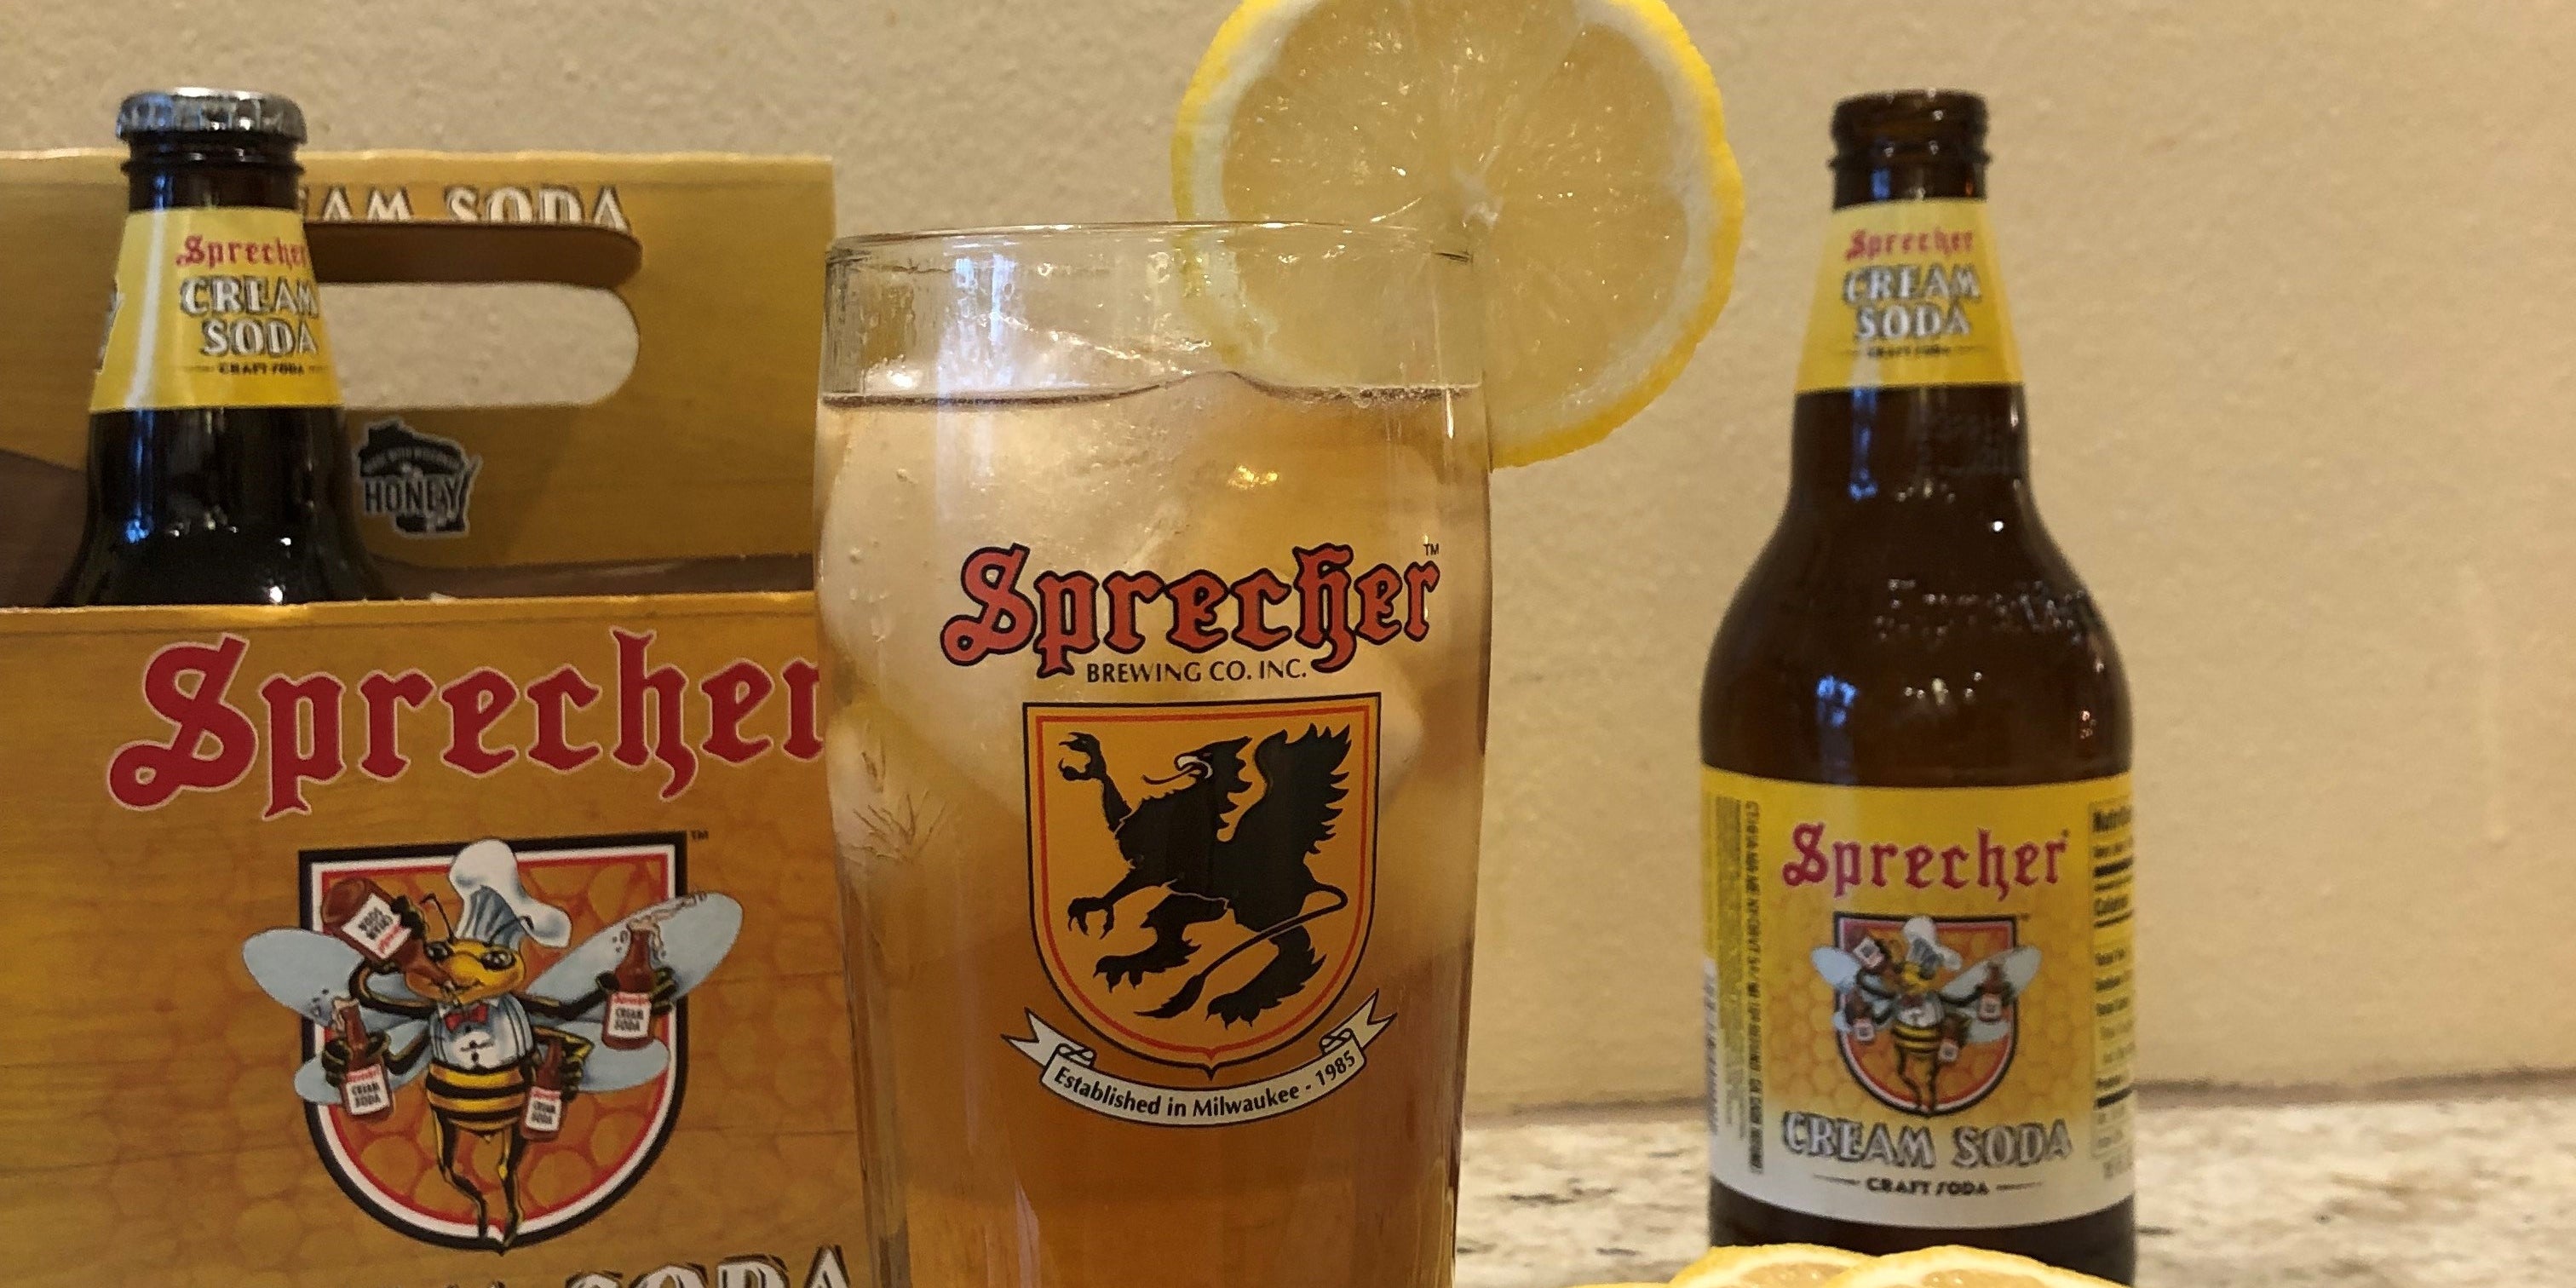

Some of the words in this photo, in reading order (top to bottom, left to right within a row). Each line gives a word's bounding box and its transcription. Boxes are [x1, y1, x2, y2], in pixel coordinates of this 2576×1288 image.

[180, 273, 319, 319] CREAM
[1842, 262, 1982, 308] CREAM
[199, 316, 319, 358] SODA
[1854, 299, 1972, 342] SODA
[365, 476, 465, 513] HONEY
[940, 543, 1440, 678] Sprecher
[1086, 661, 1202, 683] BREWING
[1208, 659, 1252, 682] CO.
[1258, 658, 1308, 680] INC.
[1781, 821, 2067, 901] Sprecher
[1052, 1066, 1160, 1117] Established
[1167, 1097, 1187, 1117] in
[1193, 1084, 1300, 1118] Milwaukee
[1314, 1049, 1357, 1088] 1985
[1781, 1110, 1936, 1170] CREAM
[1952, 1118, 2073, 1169] SODA
[1866, 1176, 1931, 1195] CRAFT
[1935, 1179, 1991, 1199] SODA
